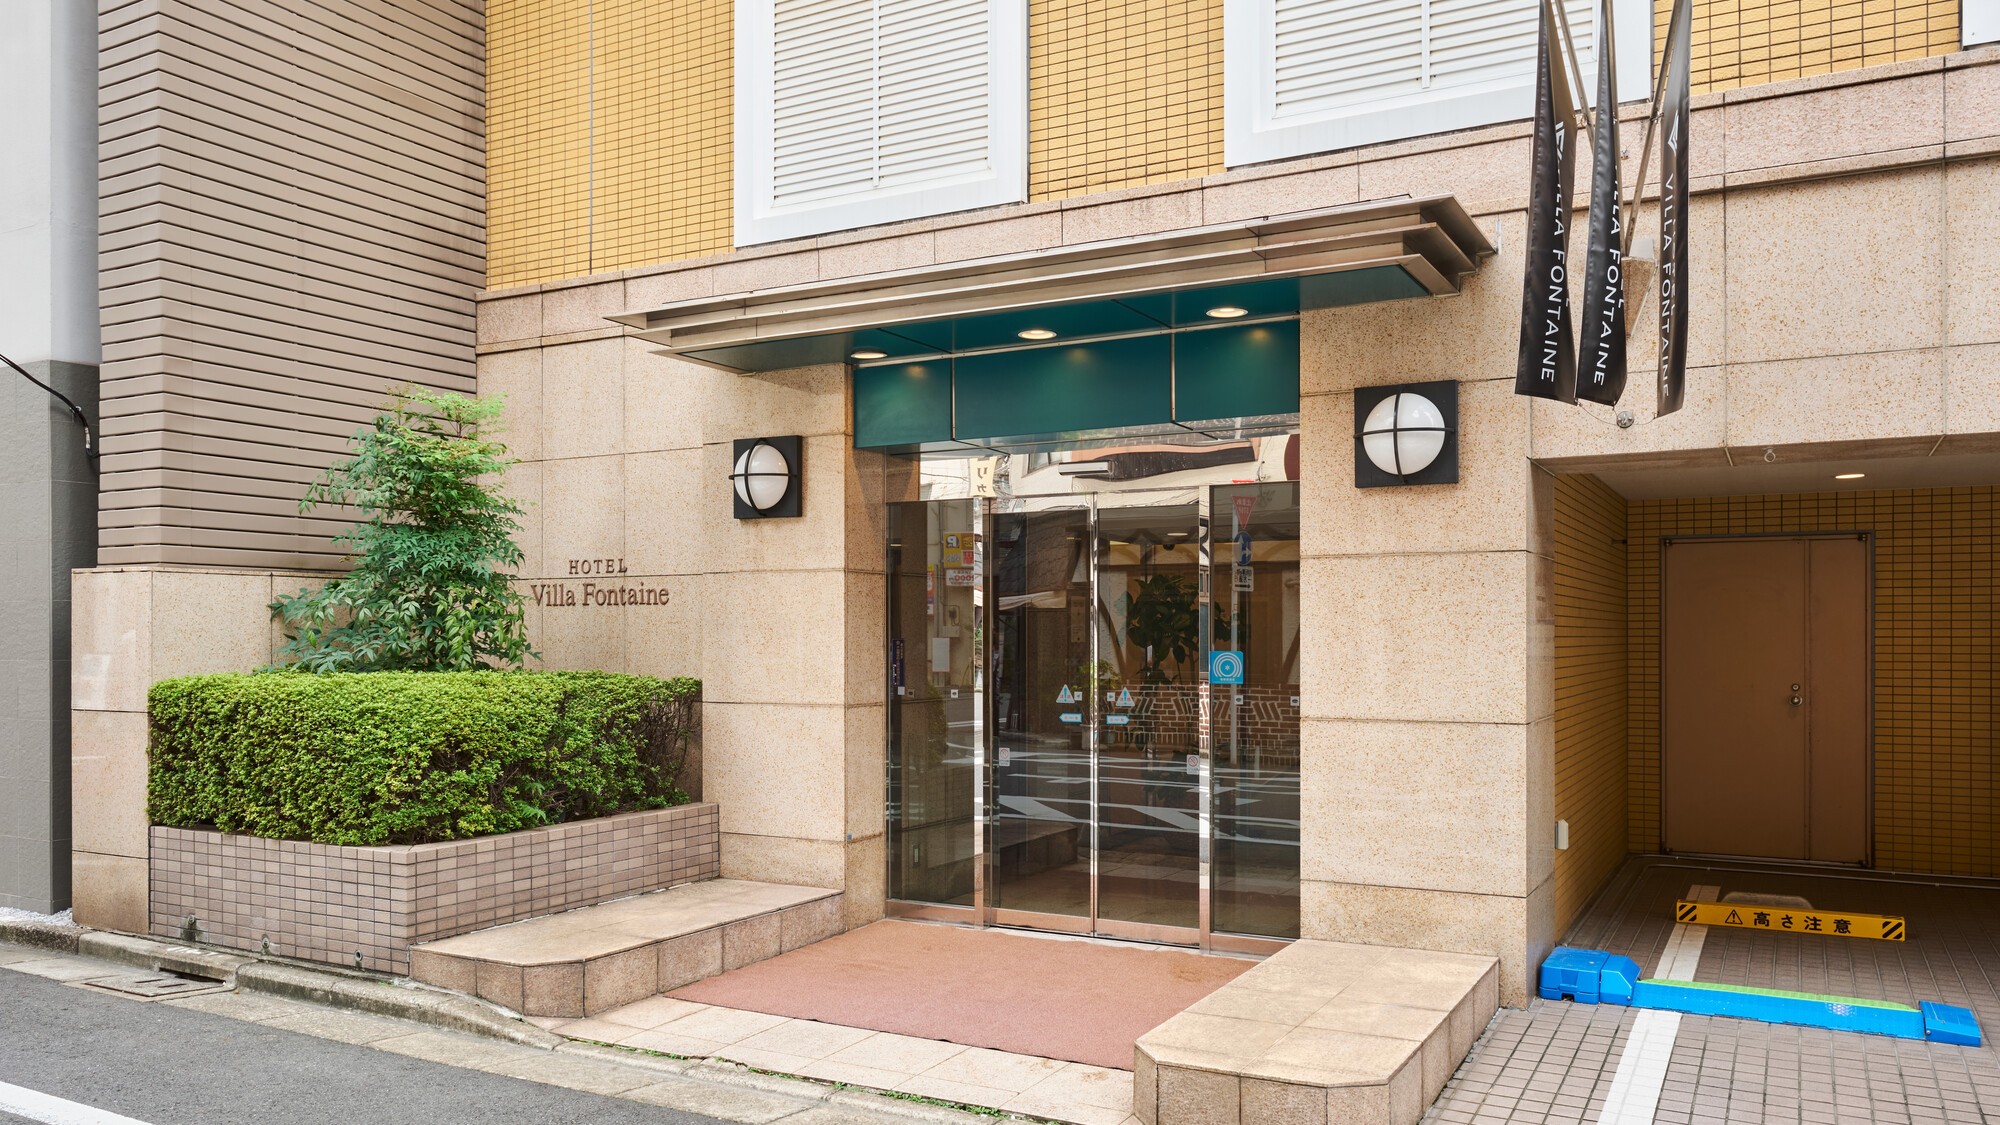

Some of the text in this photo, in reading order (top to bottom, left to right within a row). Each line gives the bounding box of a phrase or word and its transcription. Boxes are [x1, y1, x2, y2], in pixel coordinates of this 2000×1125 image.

[1663, 173, 1675, 252] VILLA
[1541, 248, 1566, 383] FONTAINE
[1594, 248, 1622, 386] FONTAINE
[568, 558, 628, 575] HOTEL
[530, 581, 670, 607] Villa Fontaine
[1753, 911, 1852, 935] 高さ注意
